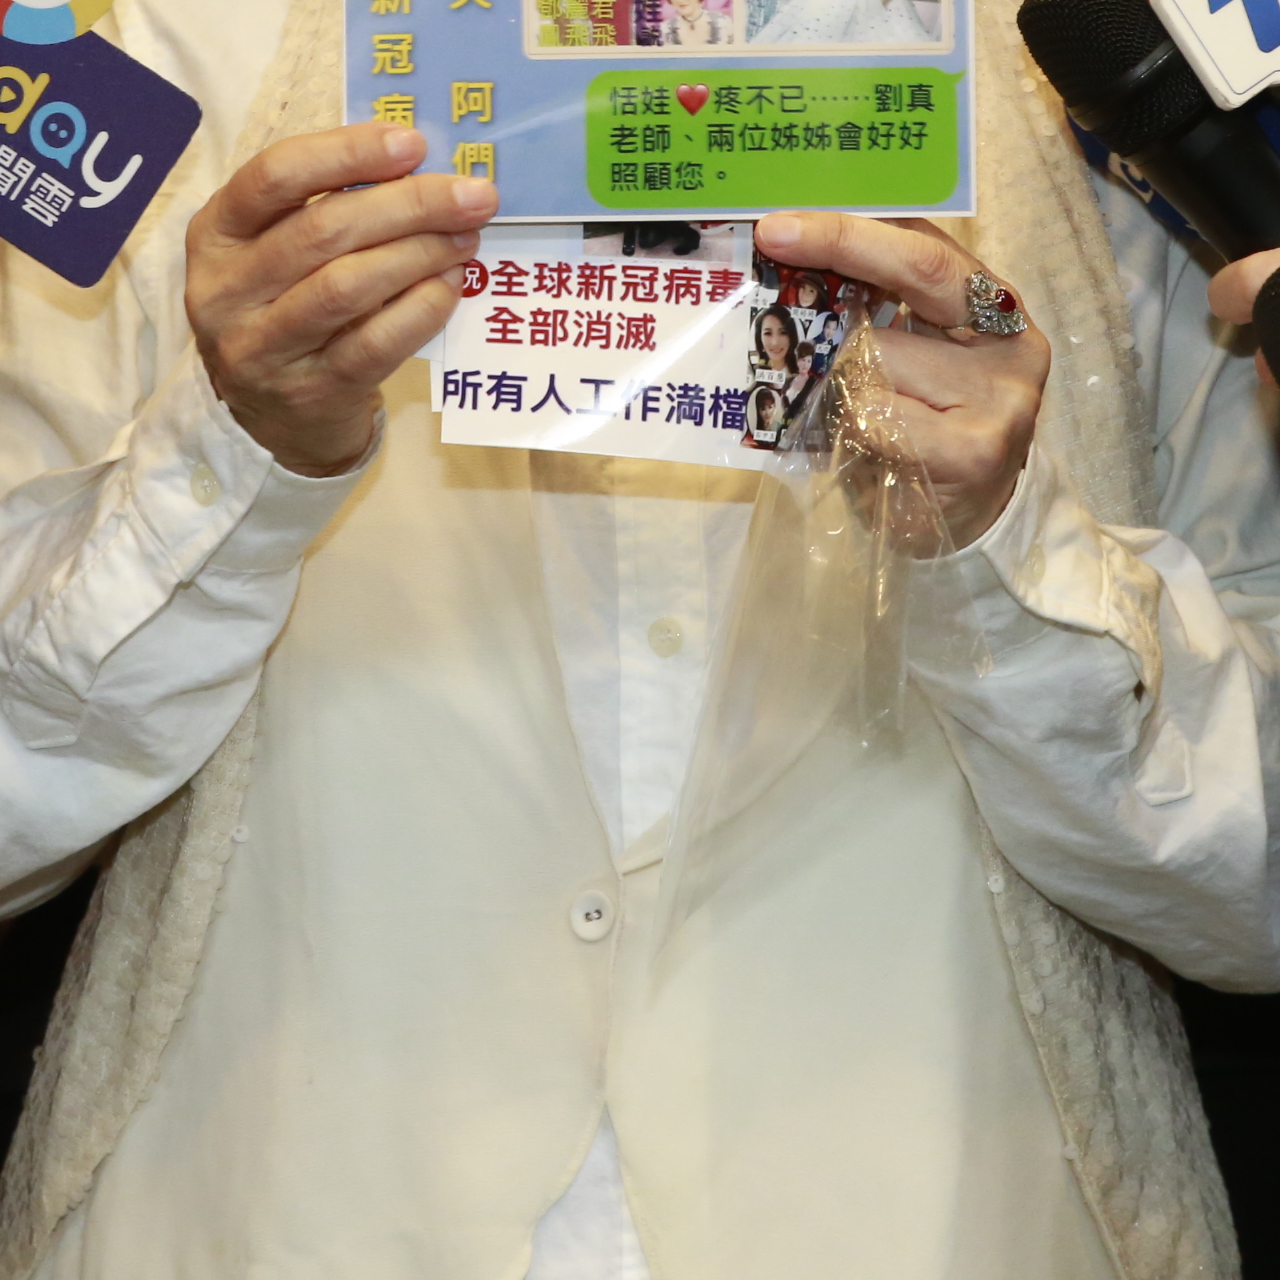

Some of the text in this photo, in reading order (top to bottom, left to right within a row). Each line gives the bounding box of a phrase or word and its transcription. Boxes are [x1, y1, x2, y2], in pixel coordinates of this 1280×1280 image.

[489, 259, 745, 310] 全球新冠病毒
[484, 306, 657, 352] 全部消滅
